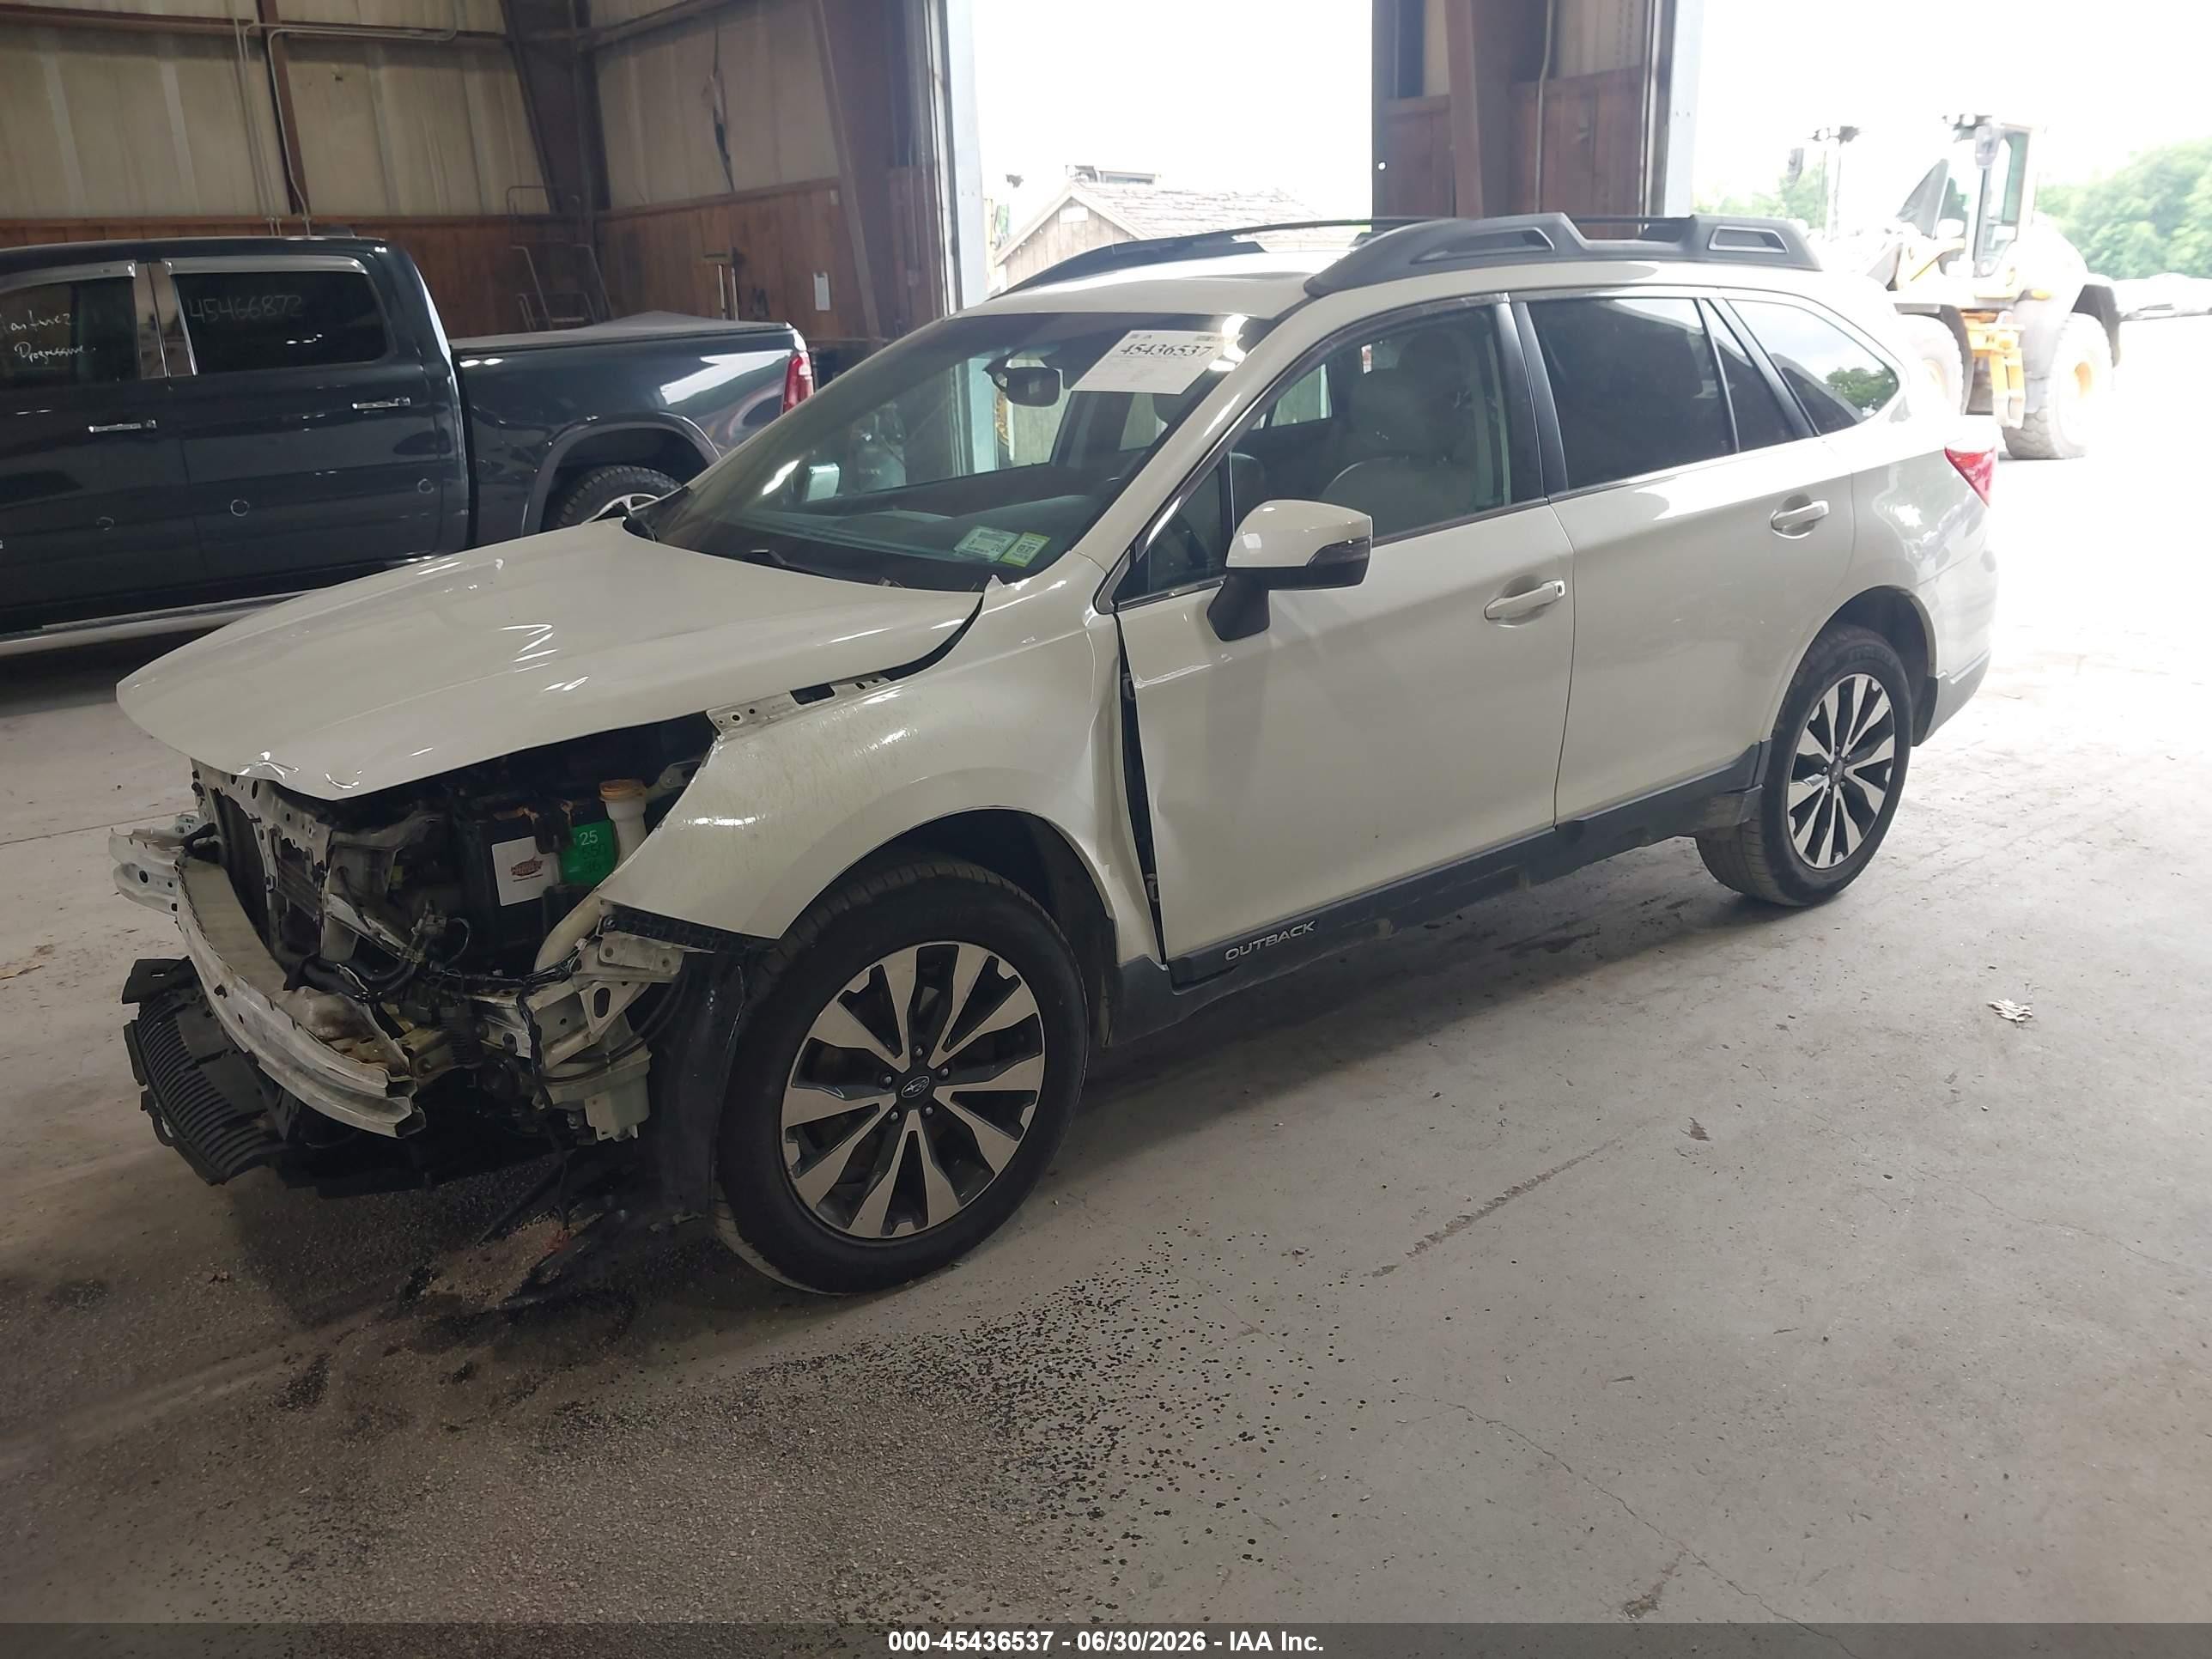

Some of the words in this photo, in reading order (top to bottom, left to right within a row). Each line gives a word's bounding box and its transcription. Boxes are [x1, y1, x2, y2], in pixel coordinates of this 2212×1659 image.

[188, 295, 303, 324] 45466872
[1121, 343, 1215, 357] 45436537
[579, 830, 599, 846] 25
[1224, 921, 1316, 961] OUTBACK
